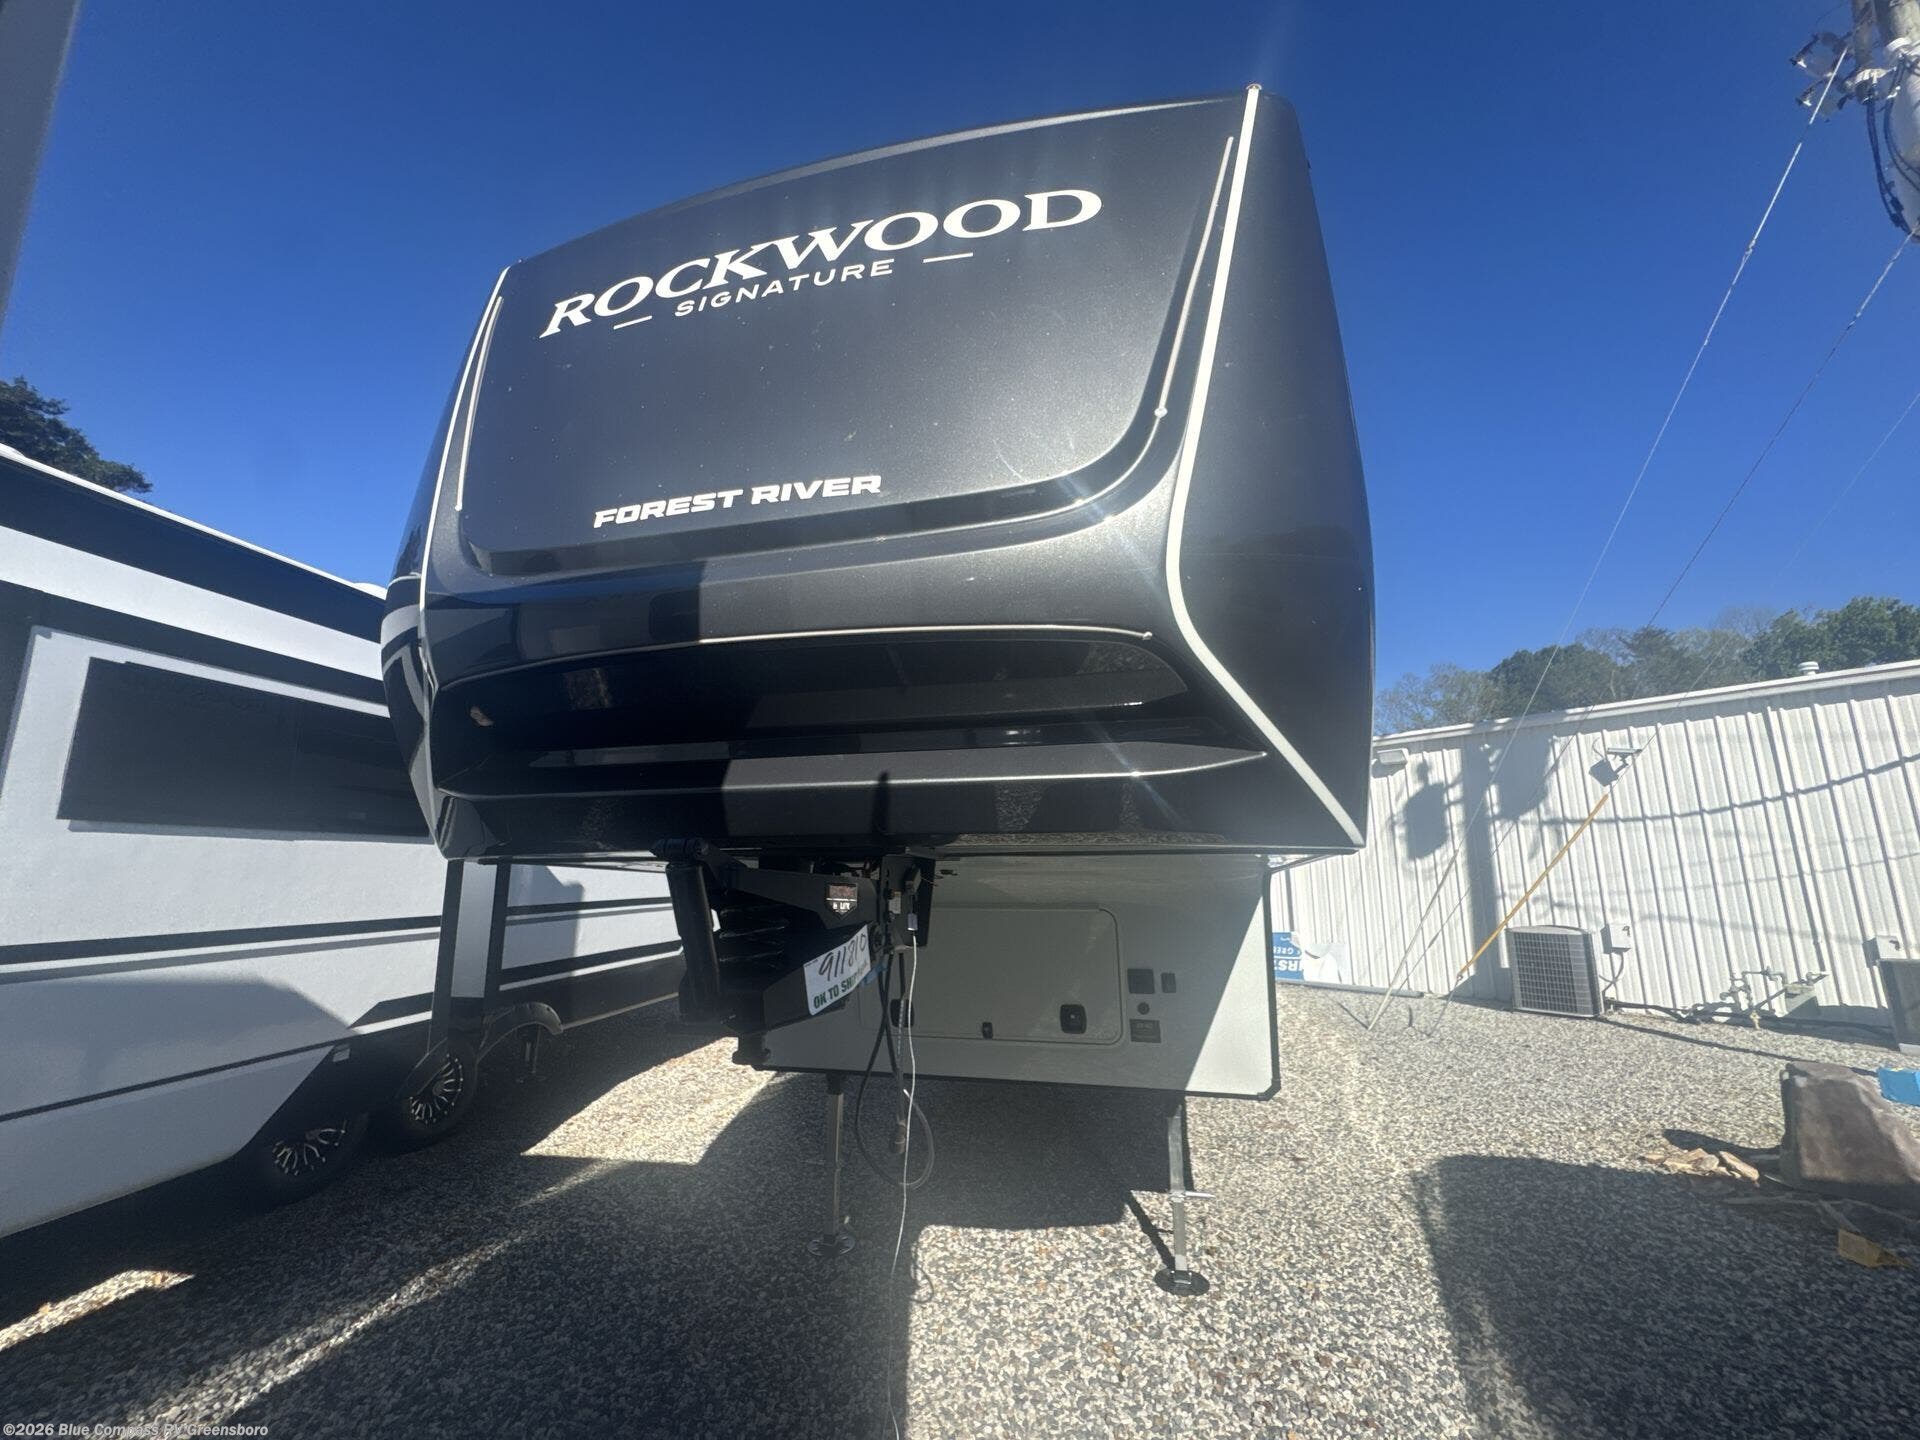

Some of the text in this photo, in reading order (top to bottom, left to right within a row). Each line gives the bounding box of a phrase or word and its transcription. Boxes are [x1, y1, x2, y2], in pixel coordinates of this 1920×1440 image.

[540, 189, 1101, 338] ROCKWOOD
[674, 258, 895, 317] SIGNATURE
[593, 475, 882, 528] FOREST RIVER
[813, 991, 827, 1009] OK
[828, 984, 840, 1000] TO
